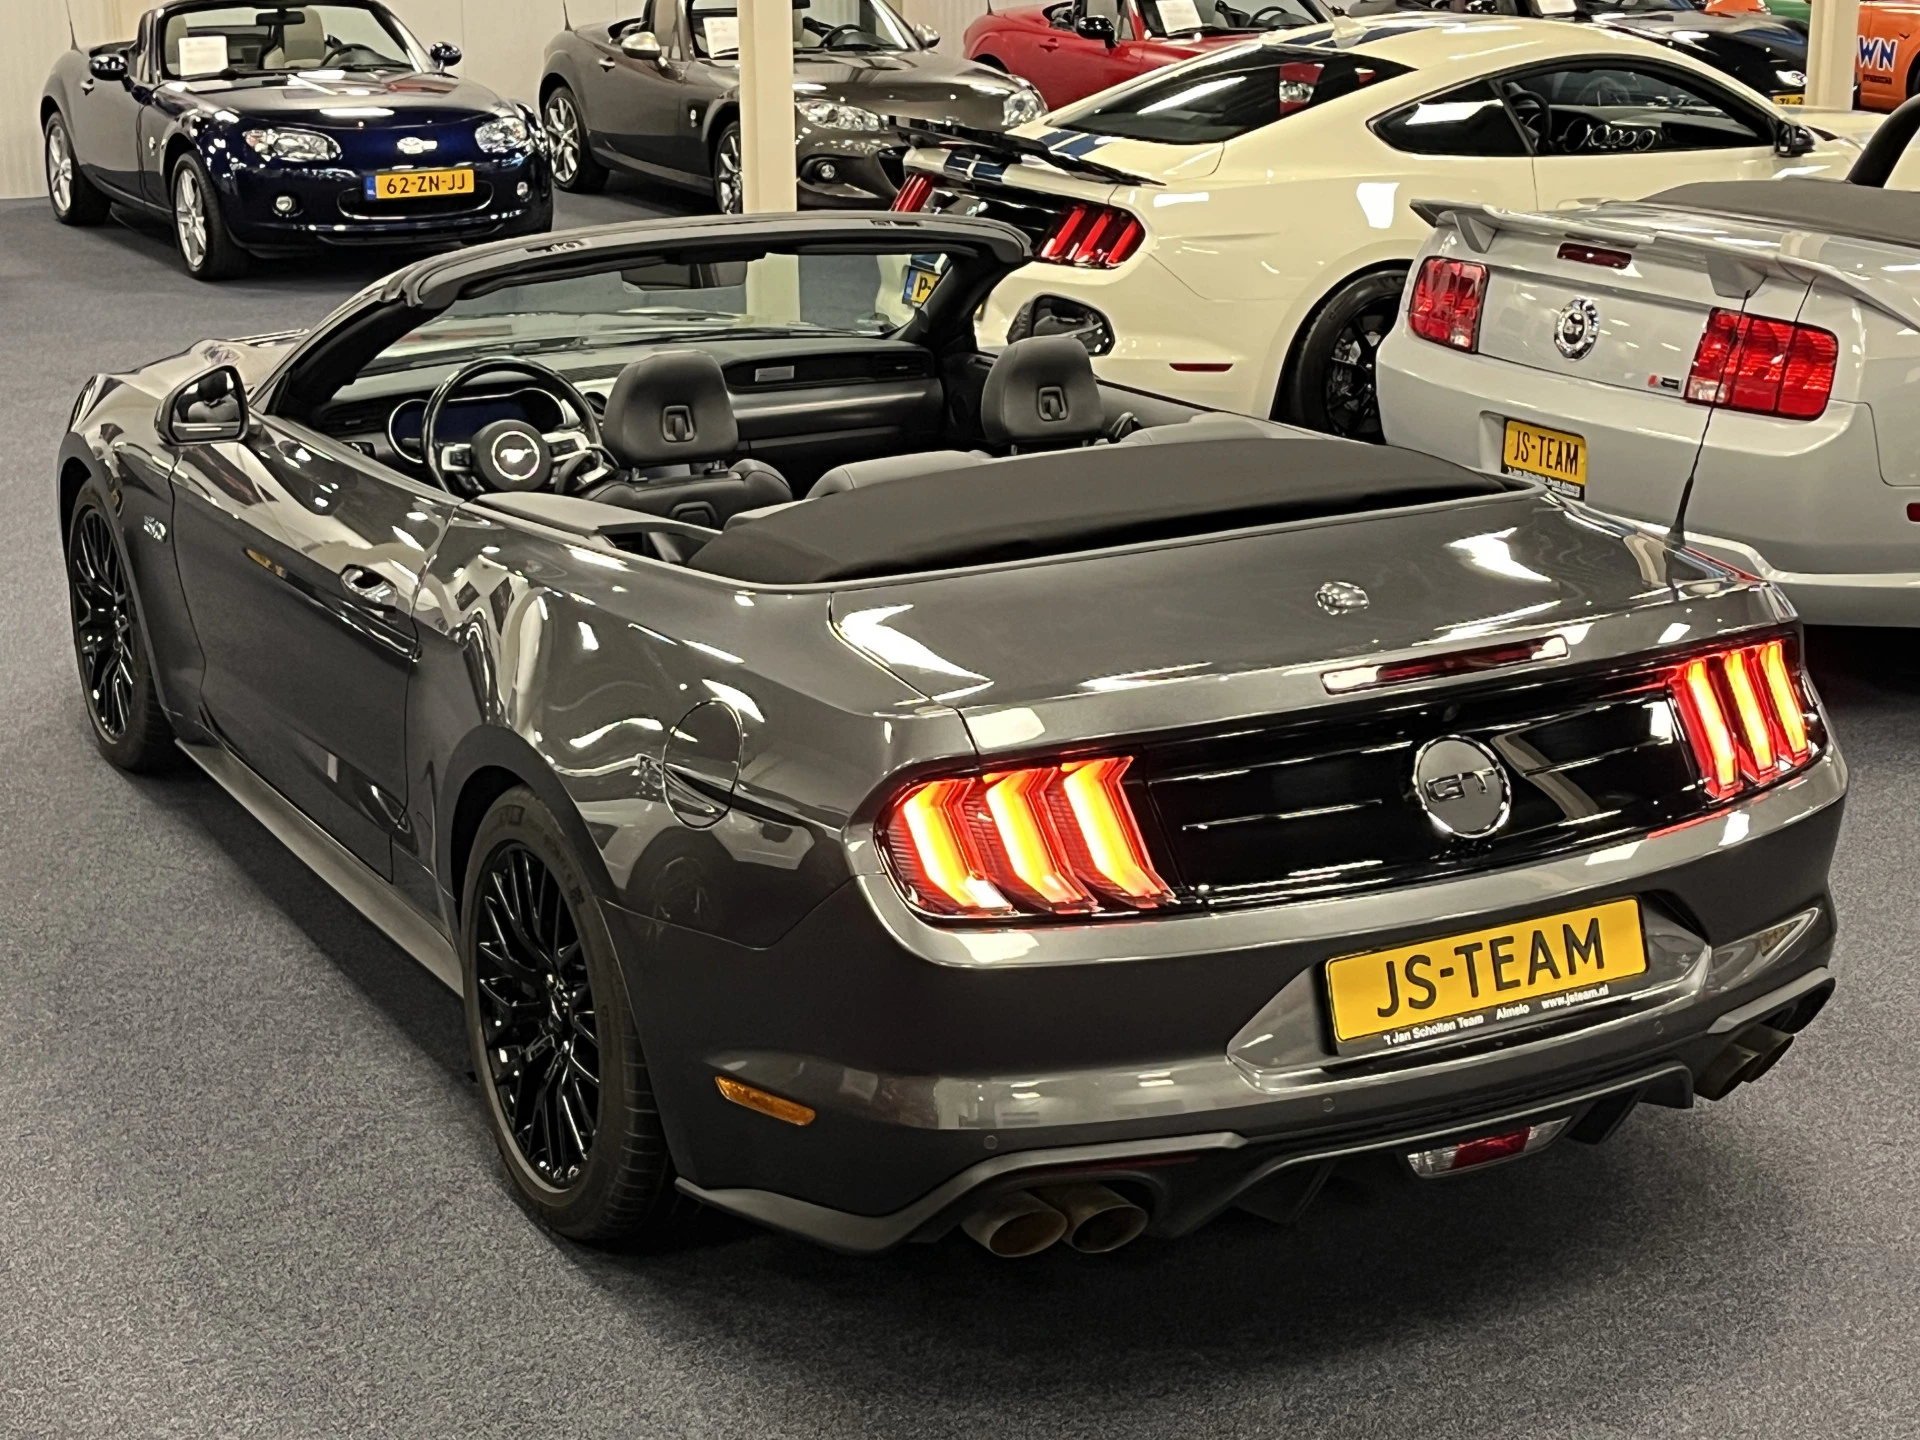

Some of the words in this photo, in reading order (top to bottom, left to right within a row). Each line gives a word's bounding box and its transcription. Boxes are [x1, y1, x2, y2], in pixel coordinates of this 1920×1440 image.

[386, 173, 466, 195] 62-ZN-JJ
[1513, 430, 1580, 476] JS-TEAM
[1424, 766, 1496, 803] GT
[1377, 917, 1605, 1018] JS-TEAM
[1392, 1026, 1412, 1044] Jan
[1412, 1020, 1457, 1039] Scholten
[1457, 1014, 1484, 1029] Team
[1495, 1003, 1531, 1021] Almelo
[1541, 983, 1610, 1010] www.jsteam.nl
